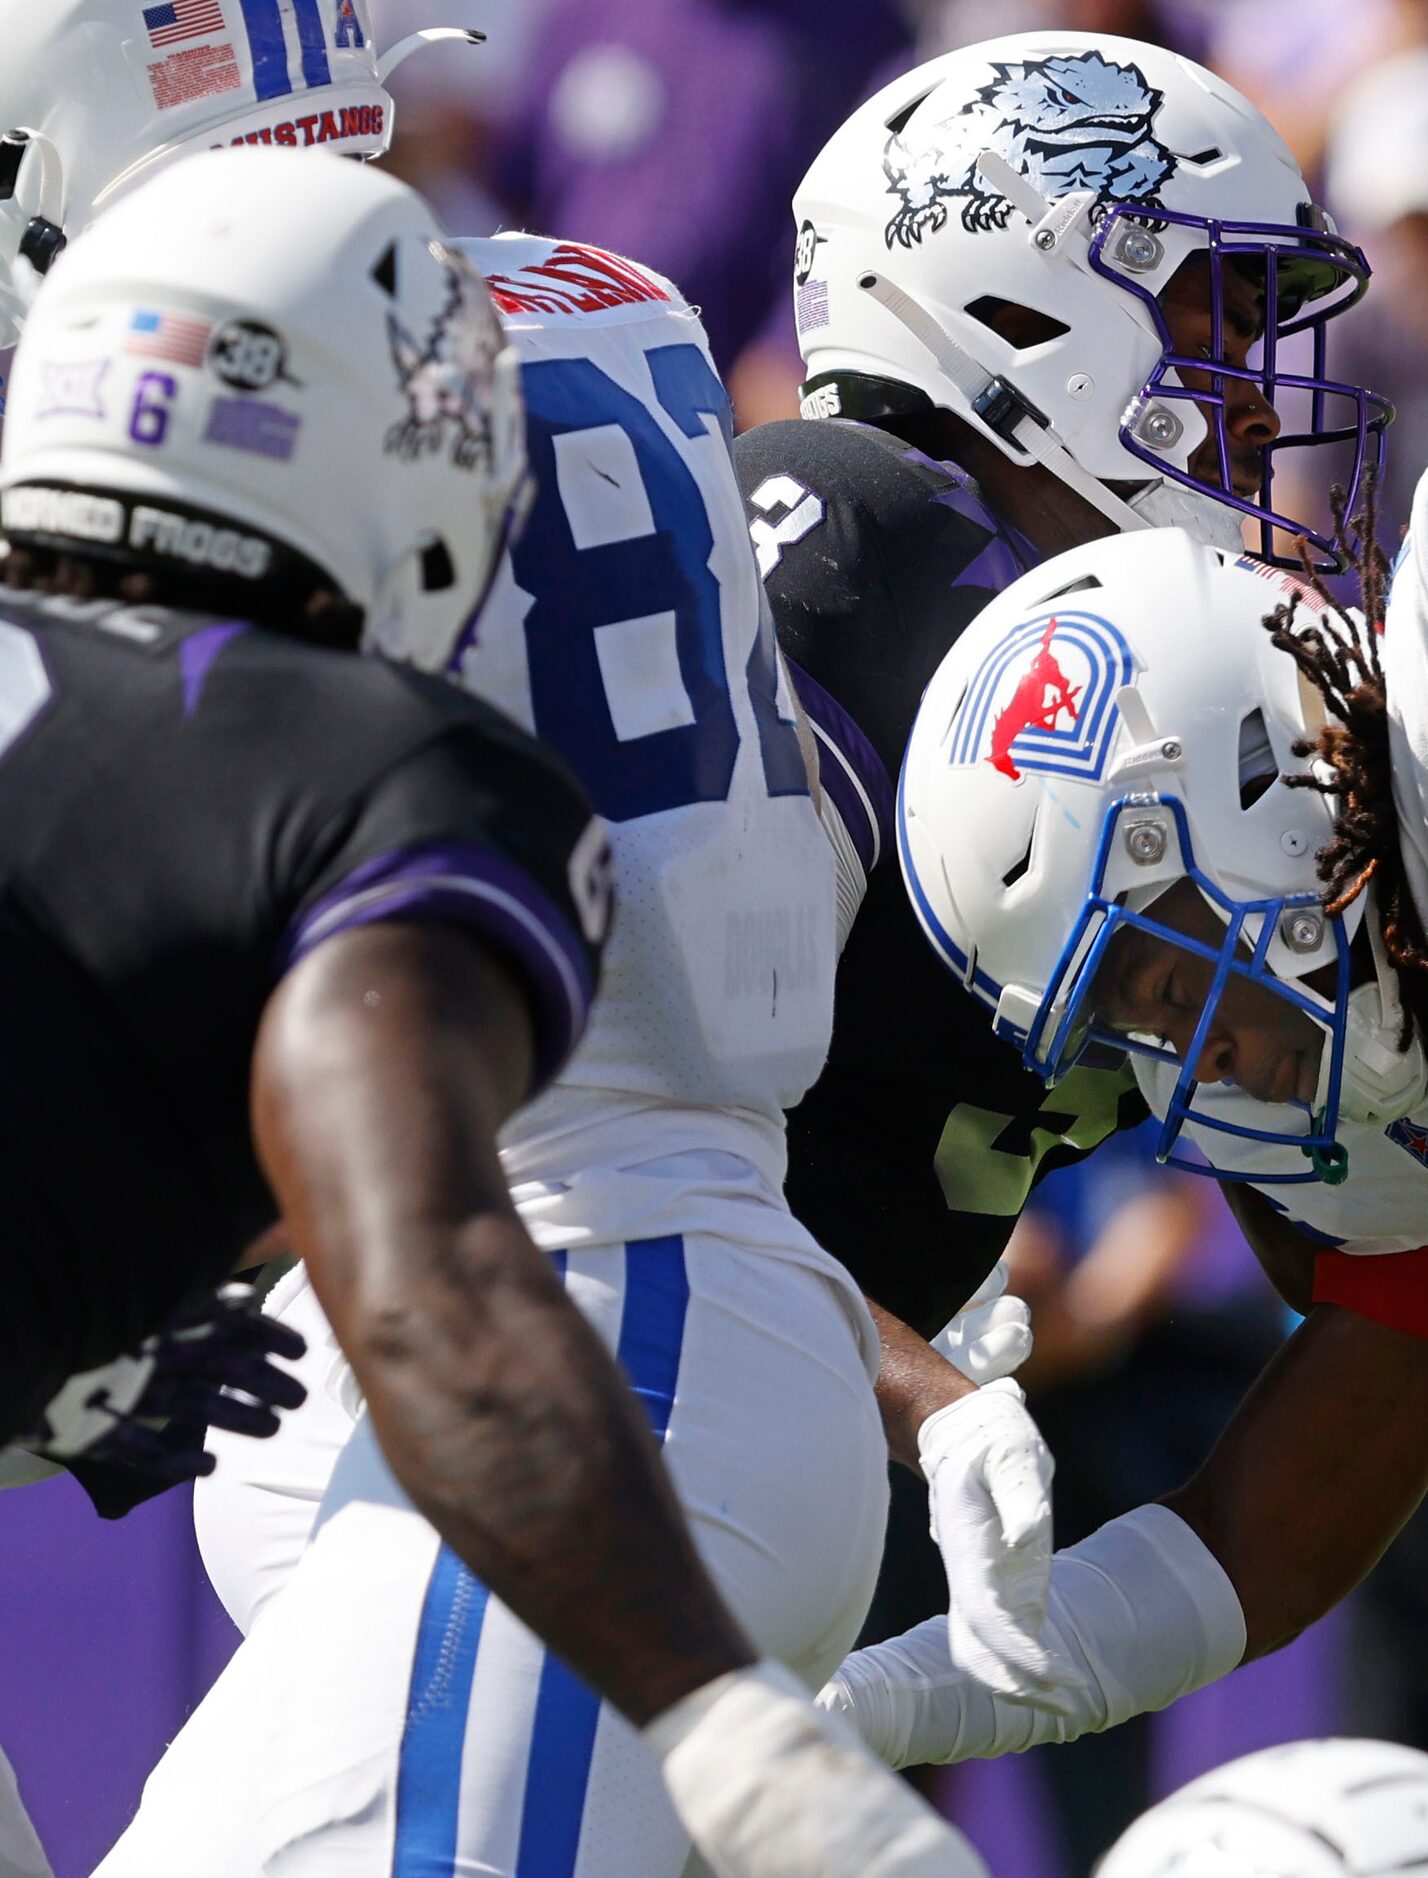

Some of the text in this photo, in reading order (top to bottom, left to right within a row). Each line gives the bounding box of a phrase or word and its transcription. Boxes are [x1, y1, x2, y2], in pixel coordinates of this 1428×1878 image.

[209, 105, 384, 151] USTANGS
[217, 327, 279, 387] 38
[129, 371, 176, 446] 6
